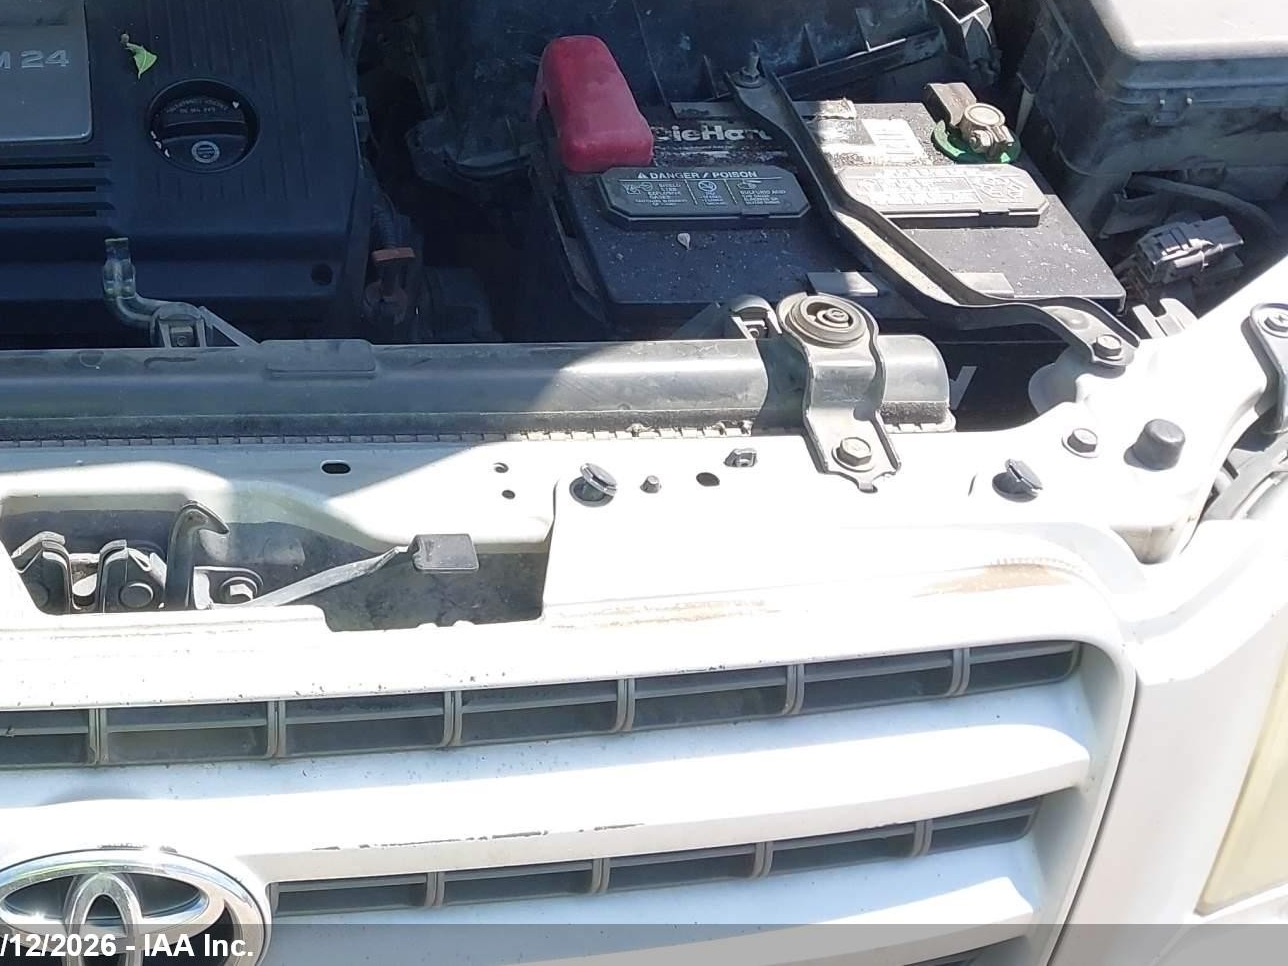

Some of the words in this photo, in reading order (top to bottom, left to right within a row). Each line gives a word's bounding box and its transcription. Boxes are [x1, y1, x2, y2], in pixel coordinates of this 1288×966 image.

[20, 49, 71, 69] 24
[649, 171, 701, 179] DANGER
[712, 171, 758, 179] POISON
